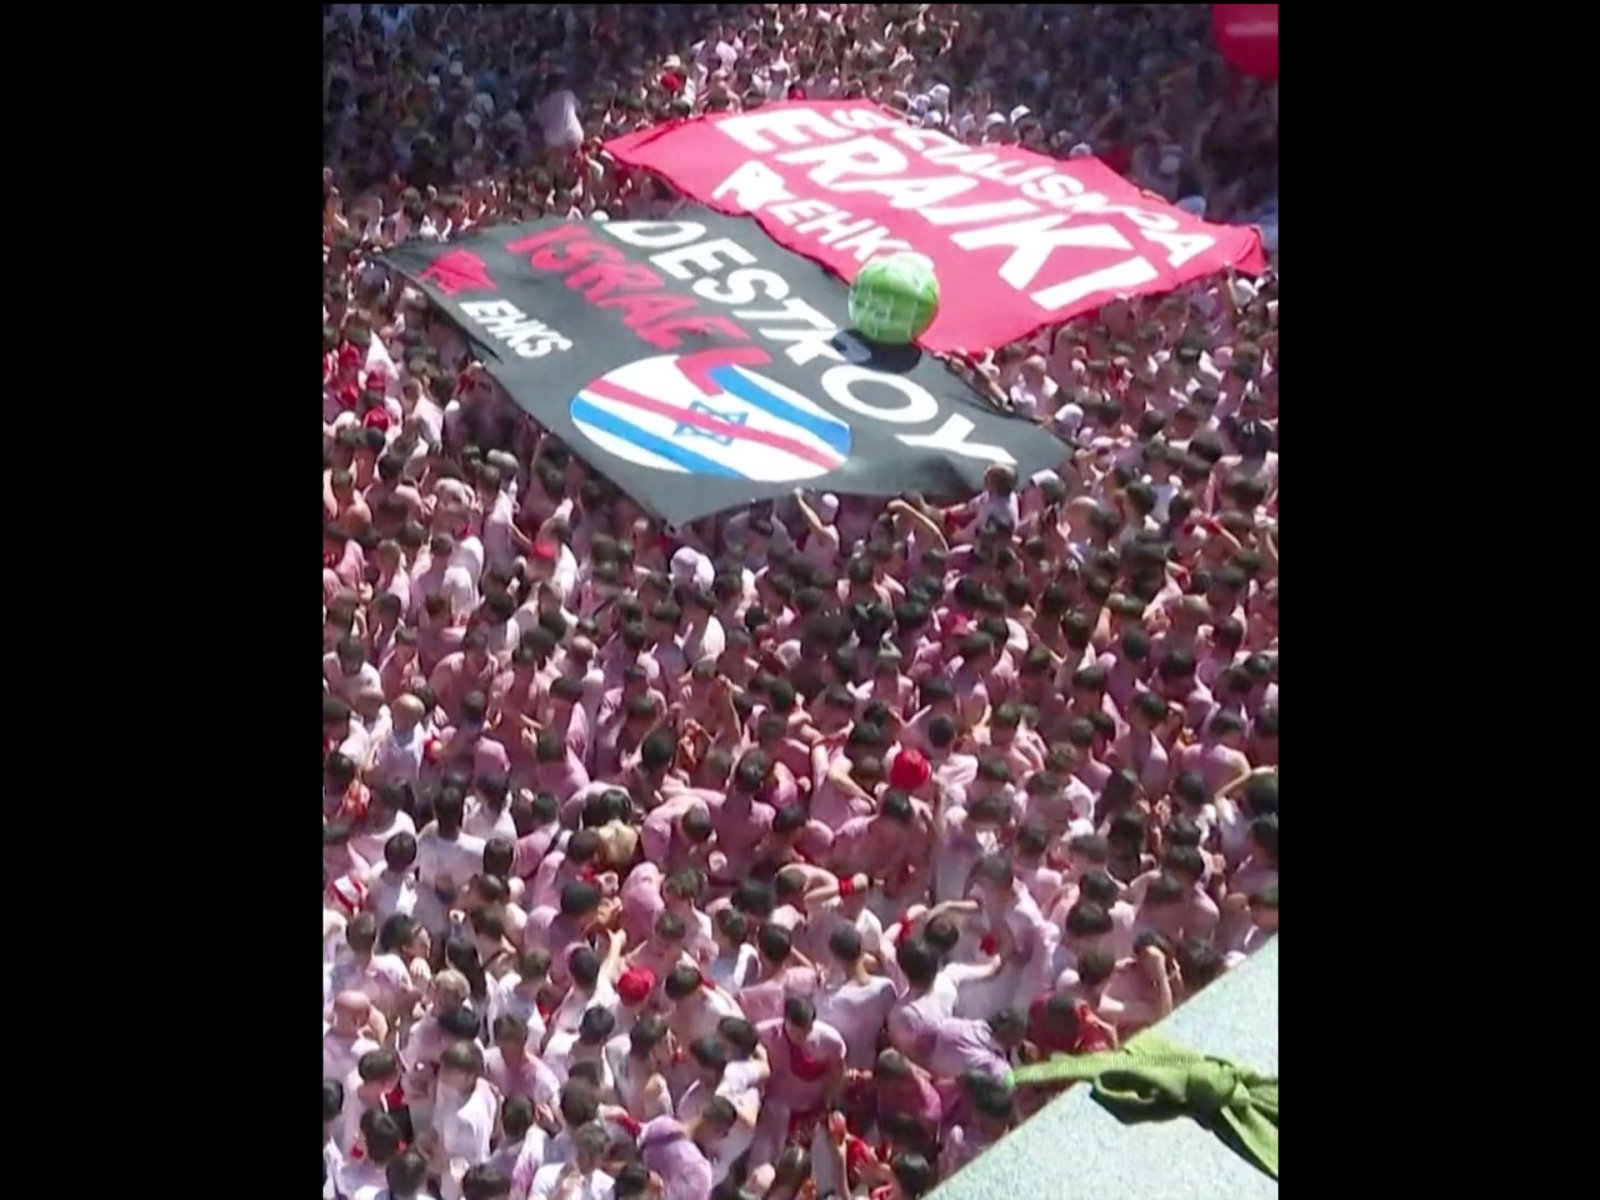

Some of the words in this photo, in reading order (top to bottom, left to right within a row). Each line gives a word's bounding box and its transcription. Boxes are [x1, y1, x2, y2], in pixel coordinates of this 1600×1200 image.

[715, 108, 1160, 310] ERAIKI
[832, 107, 1217, 268] SZIALISOA
[459, 299, 573, 358] EHKS
[505, 222, 773, 396] ISRAEL
[602, 220, 1018, 465] DESTROY
